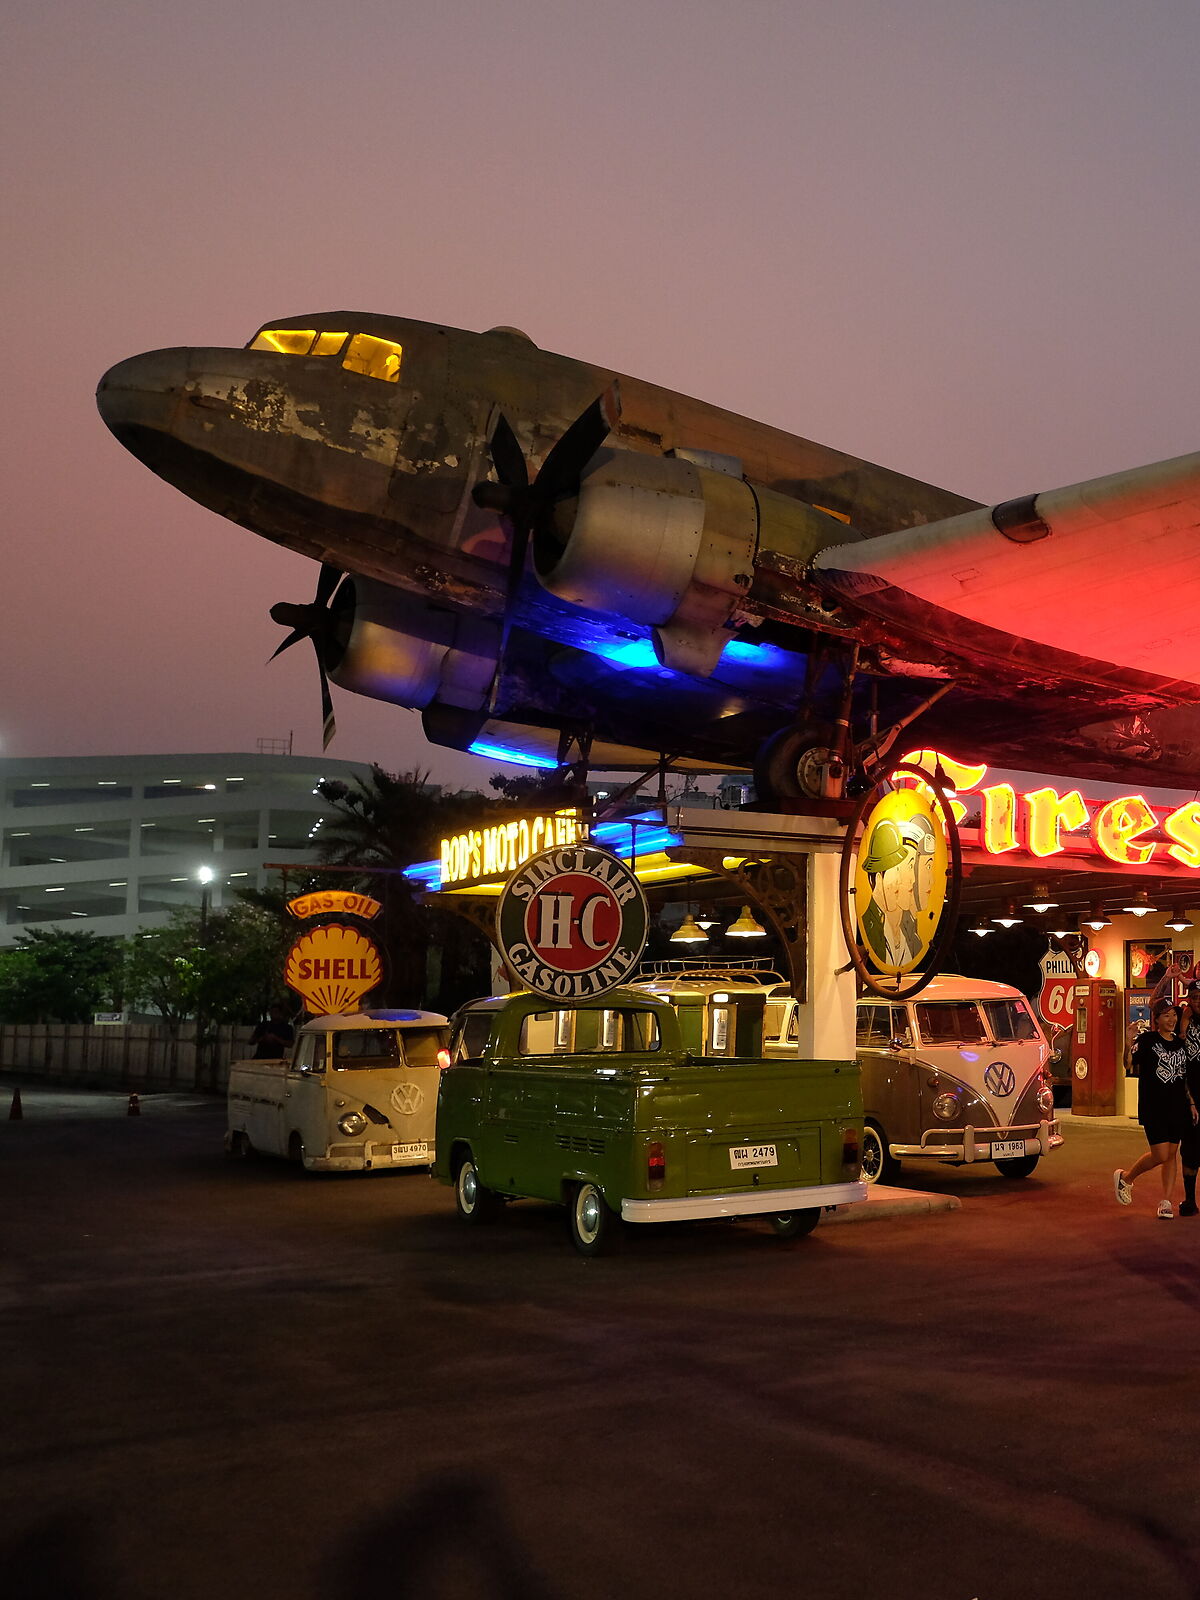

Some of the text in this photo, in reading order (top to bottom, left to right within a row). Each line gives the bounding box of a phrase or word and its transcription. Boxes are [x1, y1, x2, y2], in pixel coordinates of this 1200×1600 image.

[440, 829, 482, 884] ROD'S
[483, 818, 529, 876] MOTO
[511, 850, 638, 906] SINCLAIR
[293, 894, 375, 917] GAS-OIL
[537, 894, 612, 951] H-C
[298, 958, 372, 980] SHELL
[508, 942, 635, 997] GASOLINE
[1046, 960, 1083, 974] PHILLI
[409, 1144, 427, 1152] 4970
[753, 1146, 775, 1158] 2479
[1008, 1141, 1024, 1151] 1963
